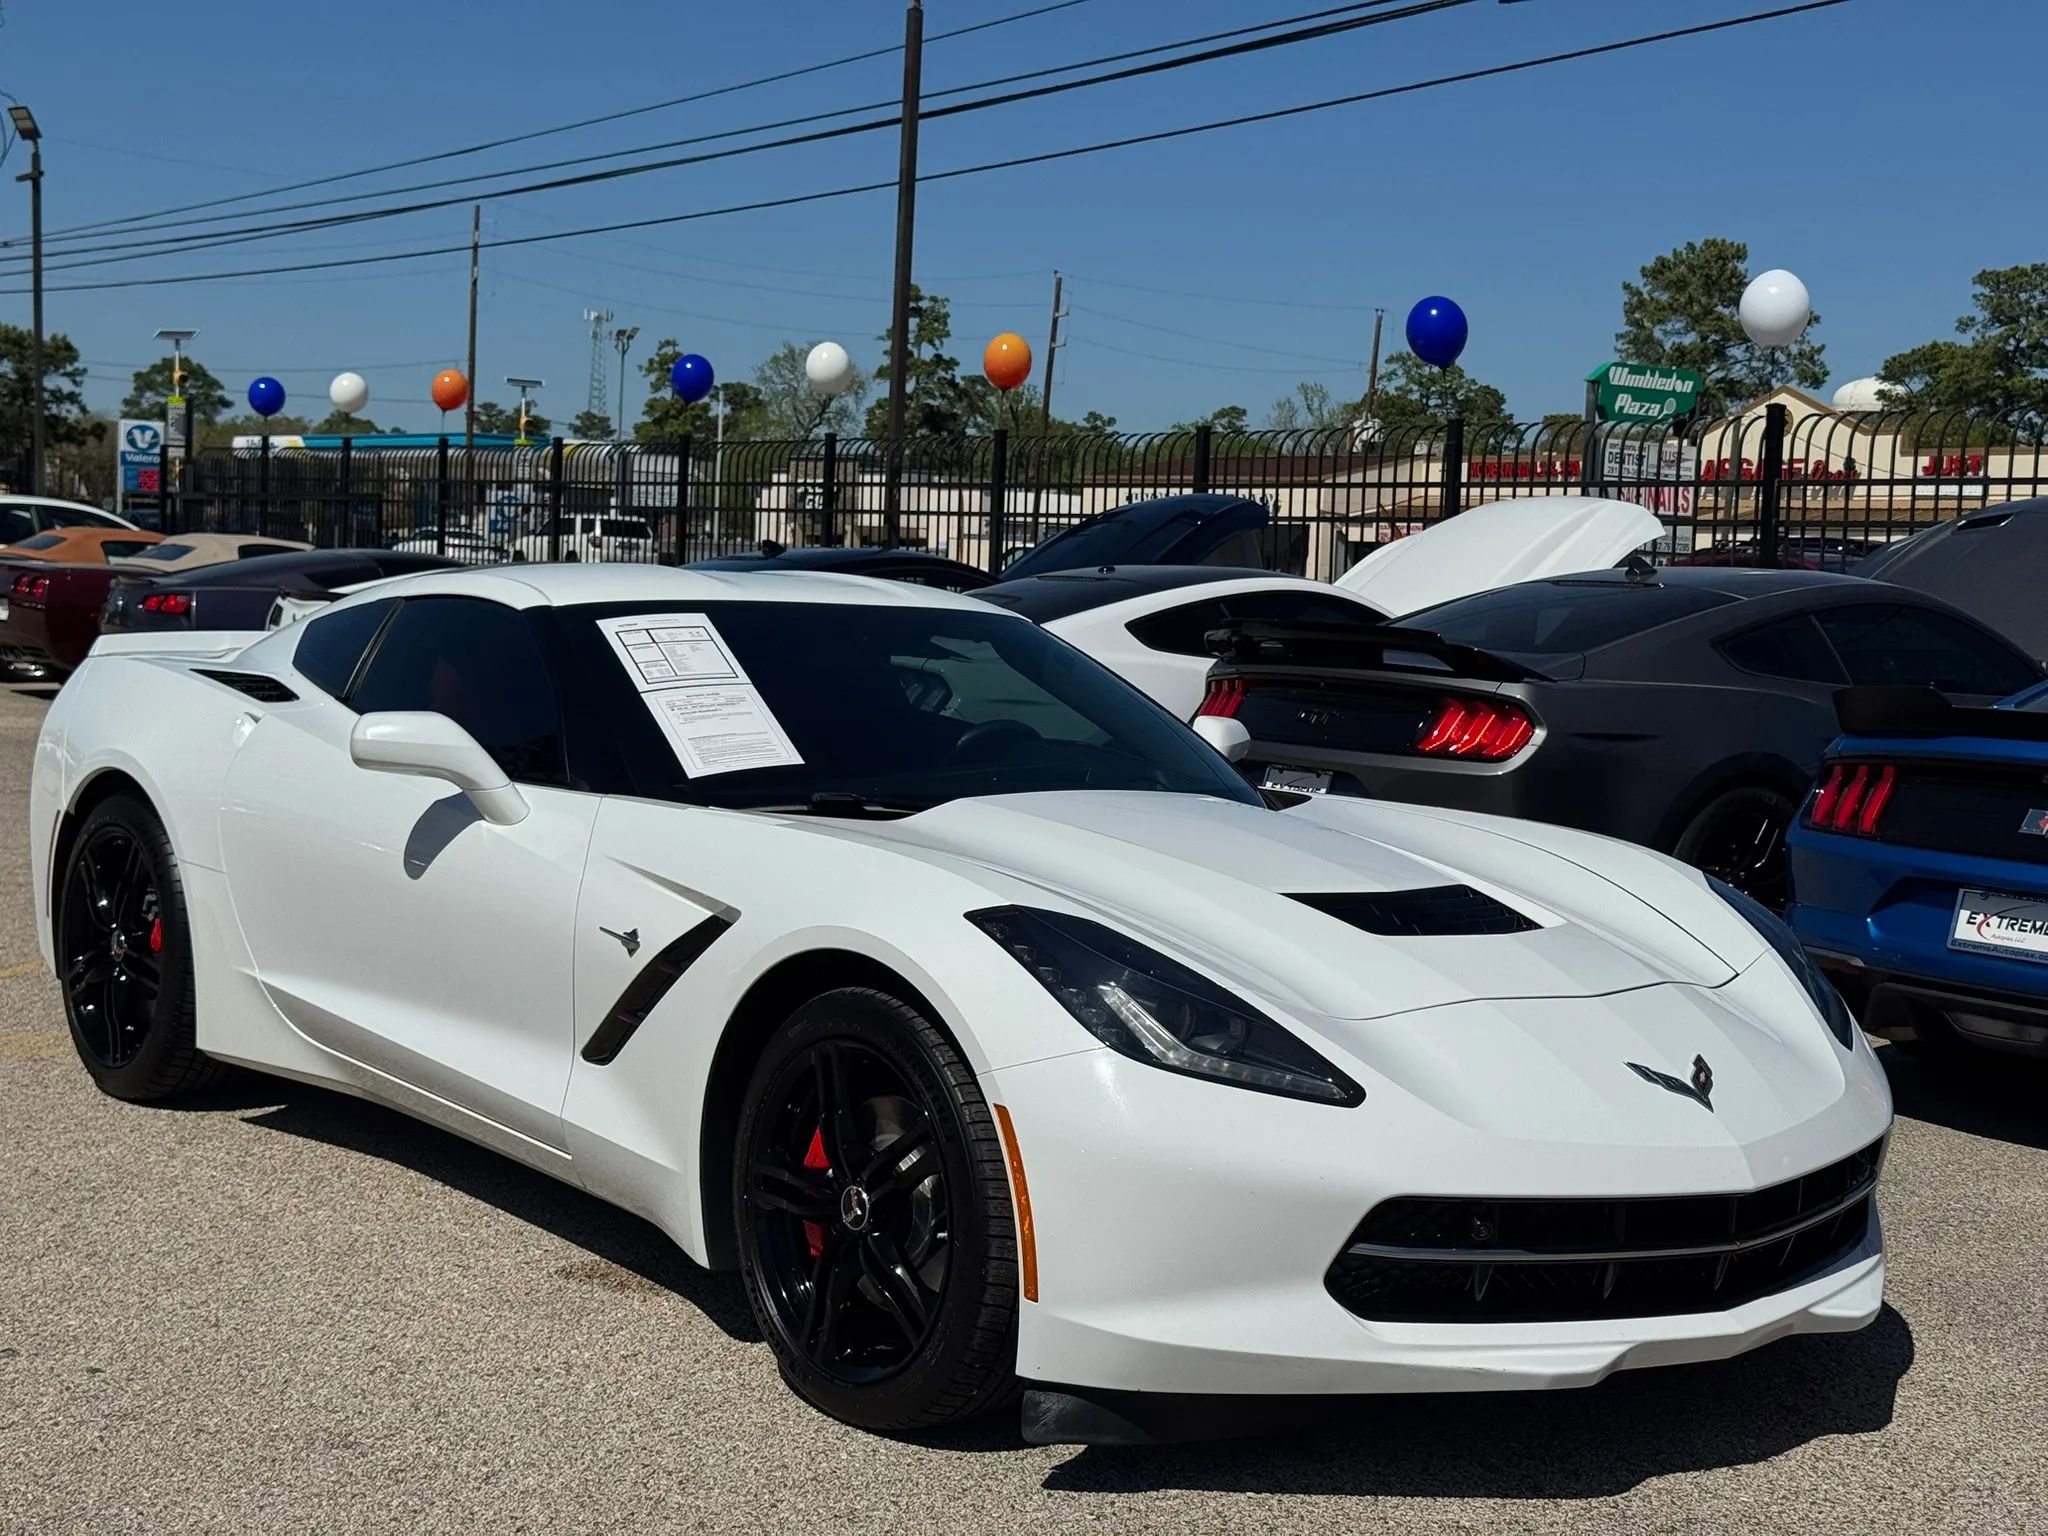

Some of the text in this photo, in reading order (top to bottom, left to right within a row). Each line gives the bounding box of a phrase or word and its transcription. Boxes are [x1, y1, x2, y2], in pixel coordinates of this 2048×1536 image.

[1609, 366, 1694, 393] Wimbledon
[1614, 393, 1661, 417] Plaza
[126, 453, 160, 463] Valero
[1647, 486, 1690, 513] NAIS
